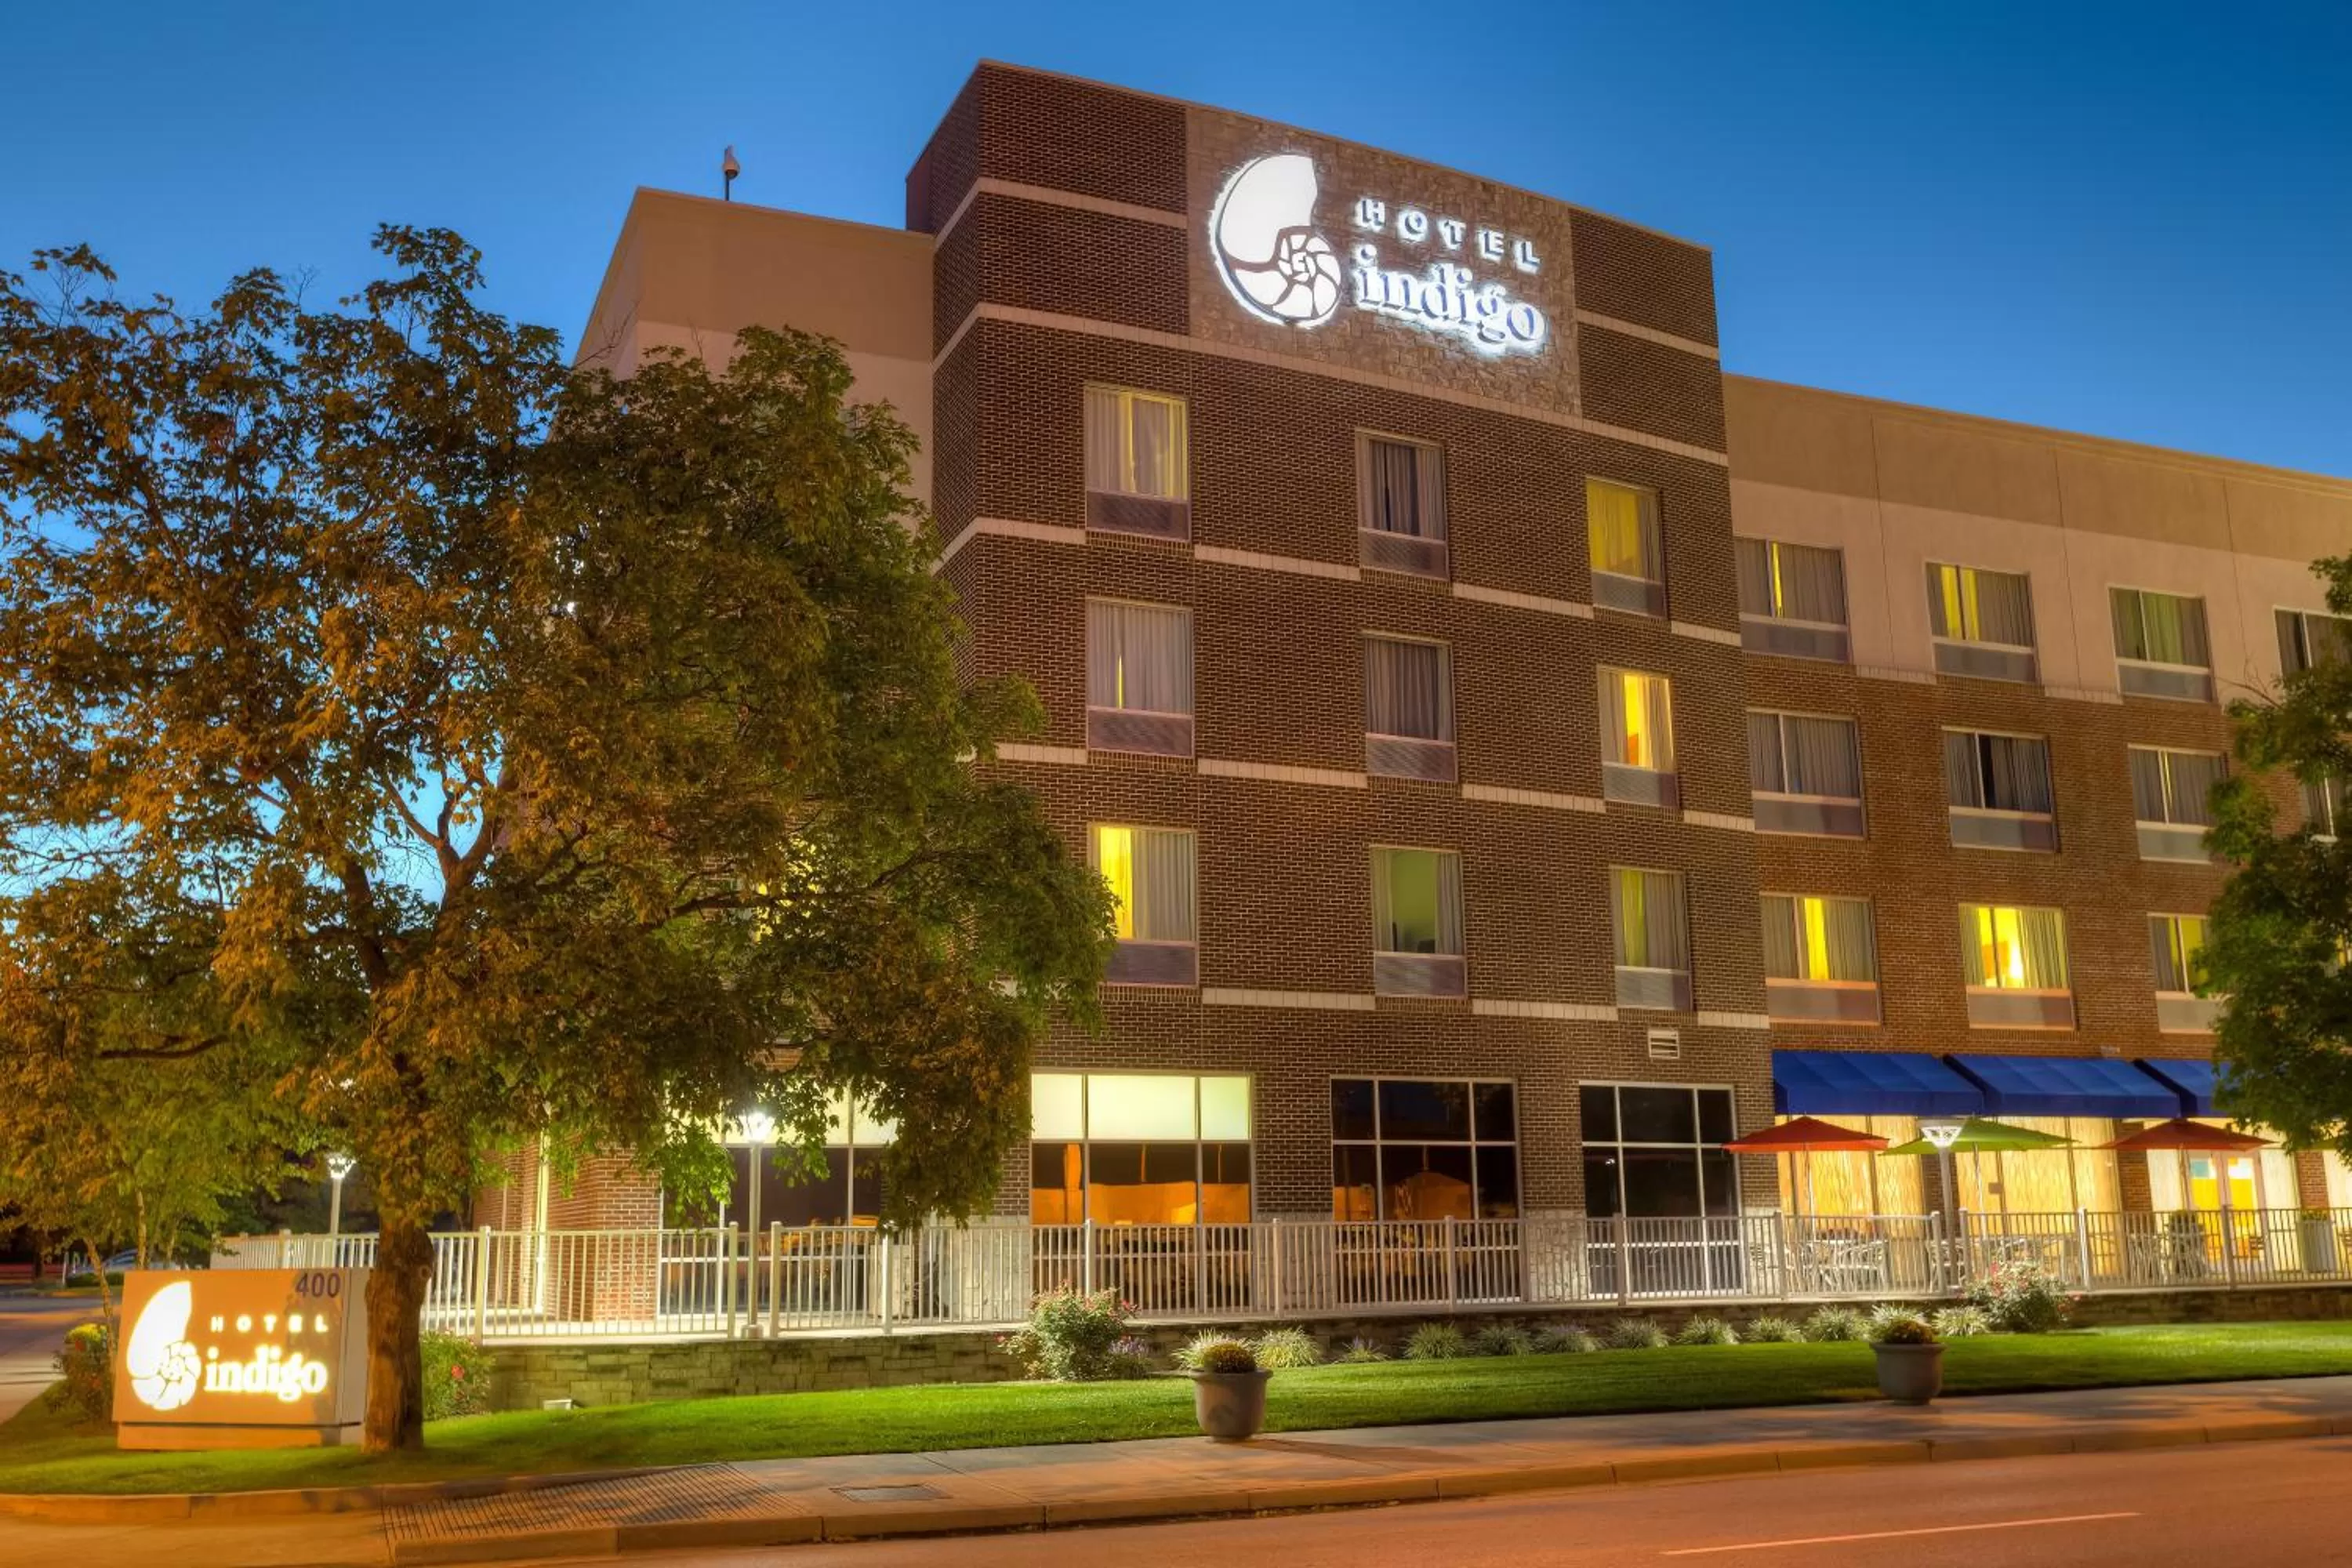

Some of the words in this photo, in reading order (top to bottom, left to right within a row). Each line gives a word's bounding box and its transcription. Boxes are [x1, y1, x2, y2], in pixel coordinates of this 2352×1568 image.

[1356, 198, 1541, 273] HOTEL
[1353, 245, 1547, 350] indigo
[296, 1272, 340, 1298] 400
[210, 1314, 328, 1333] HOTEL
[205, 1346, 328, 1402] indigo
